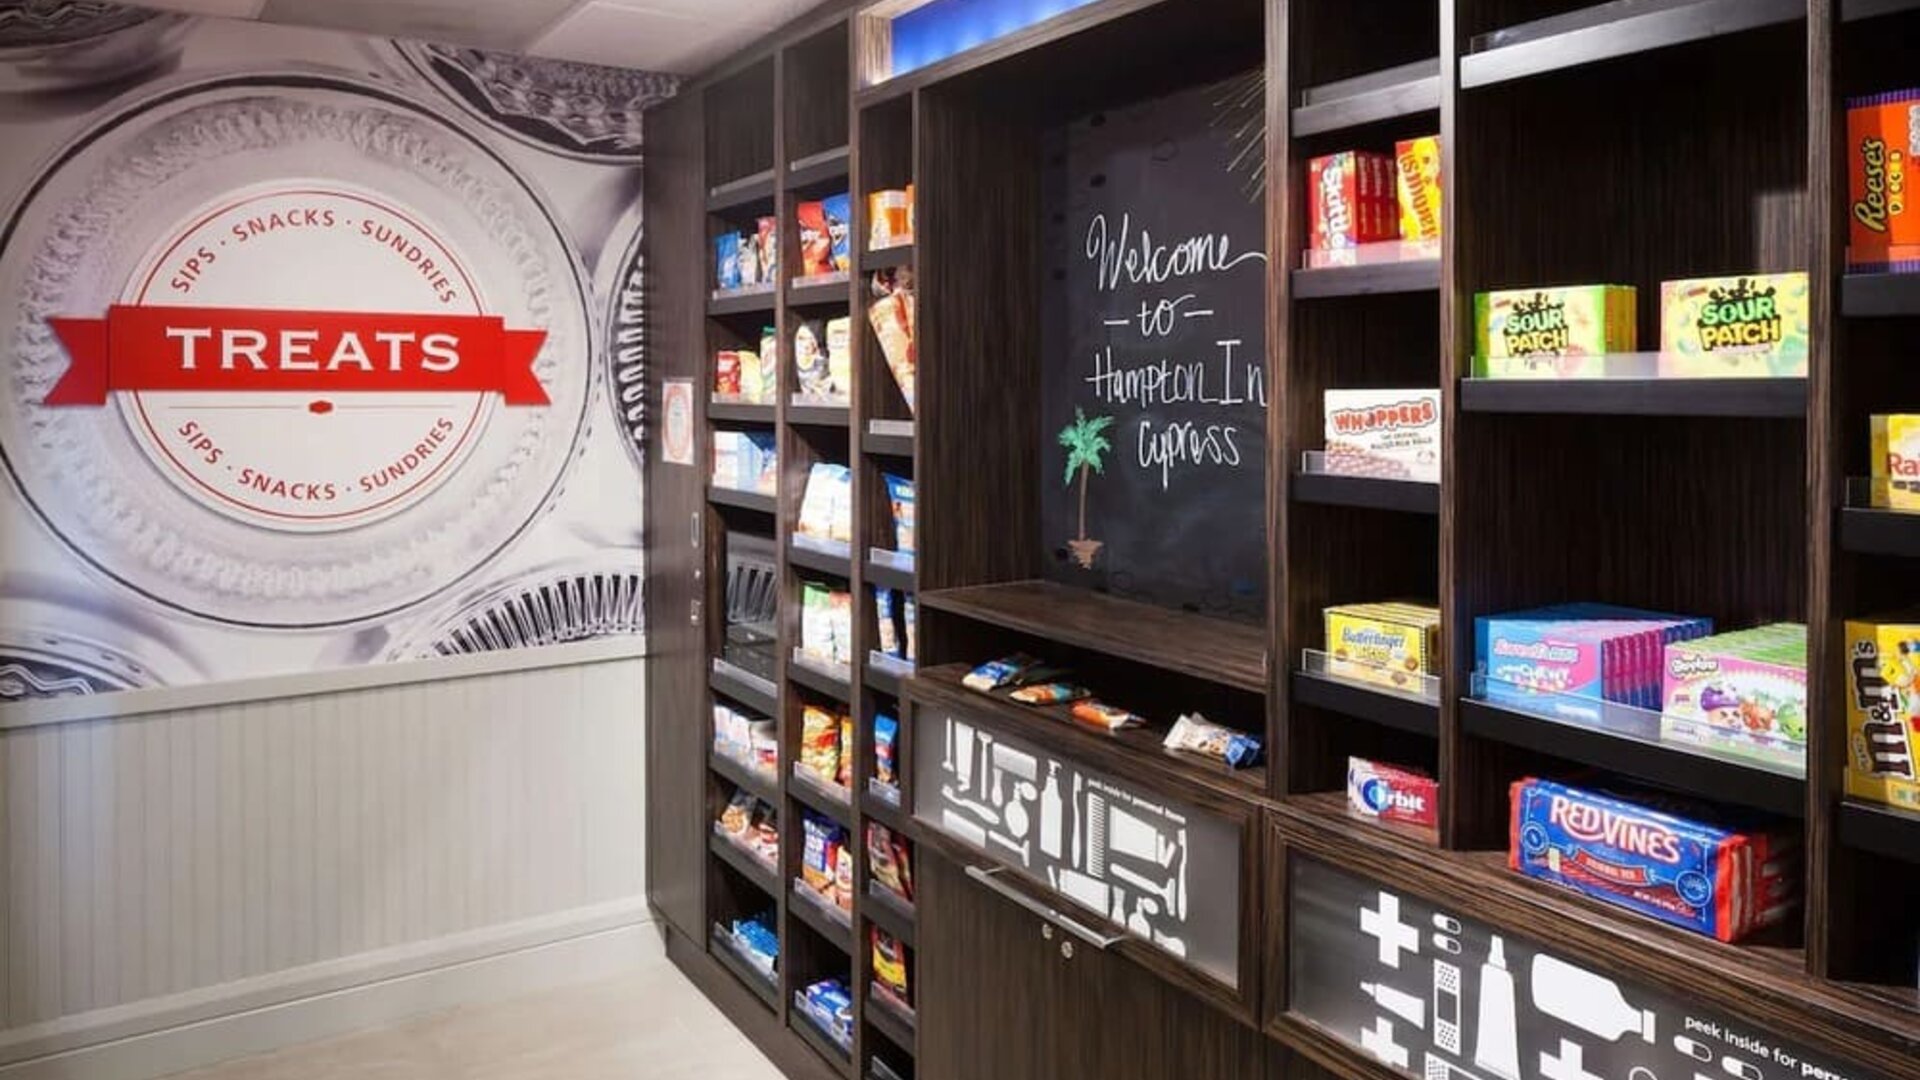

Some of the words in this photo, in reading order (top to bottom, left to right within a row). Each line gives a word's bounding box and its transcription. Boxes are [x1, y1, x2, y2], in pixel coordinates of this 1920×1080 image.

[1854, 138, 1886, 232] Reese's
[171, 245, 216, 294] SIPS
[232, 208, 335, 242] SNACKS
[360, 219, 457, 304] SUNDRIES
[1086, 212, 1268, 290] Welcome
[1136, 294, 1196, 336] to
[1507, 308, 1563, 334] SOUR
[1700, 318, 1781, 351] PATCH
[1702, 296, 1775, 325] SOUR
[165, 326, 461, 373] TREATS
[1505, 327, 1568, 356] PATCH
[1084, 346, 1218, 408] Hampton
[1334, 401, 1433, 430] WHOPPERS
[178, 420, 223, 464] SIPS
[238, 467, 335, 500] SNACKS
[360, 416, 454, 494] SUNDRIES
[1137, 420, 1241, 490] Cypress
[1886, 452, 1920, 478] Ra
[1550, 796, 1604, 840] RED
[1600, 812, 1681, 863] VINES
[1685, 1016, 1721, 1040] peek
[1724, 1027, 1769, 1058] inside
[1773, 1047, 1798, 1069] for
